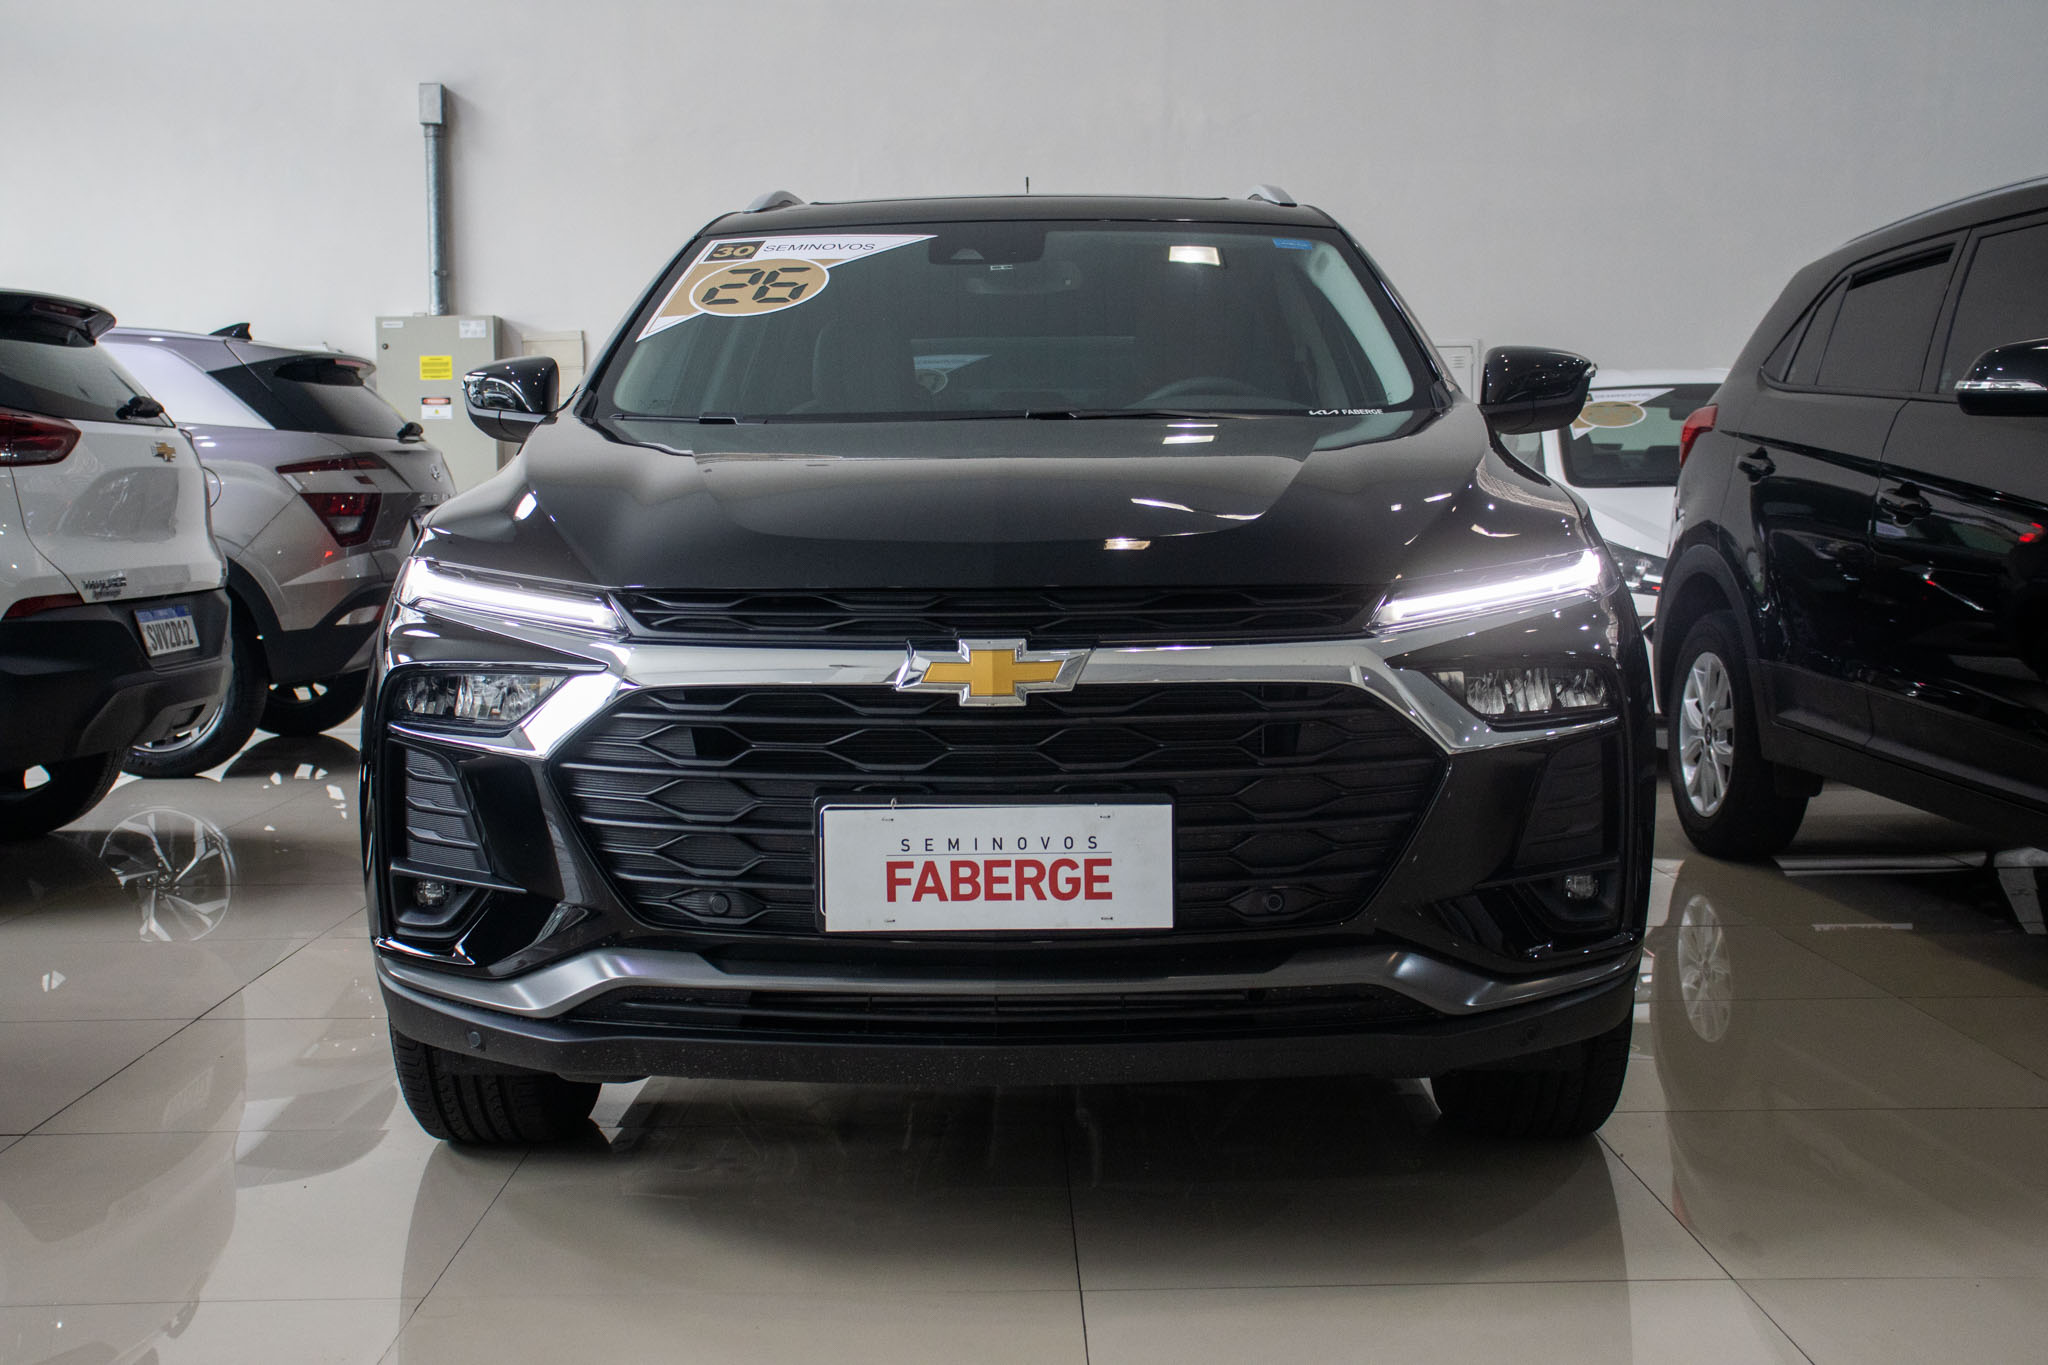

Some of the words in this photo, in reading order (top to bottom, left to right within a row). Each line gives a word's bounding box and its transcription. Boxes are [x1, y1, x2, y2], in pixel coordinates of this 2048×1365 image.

[713, 245, 755, 258] 30
[763, 242, 876, 252] SEMINOVOS
[701, 267, 811, 305] 26
[900, 836, 1098, 852] SEMINOVOS
[886, 857, 1112, 903] FABERGE
